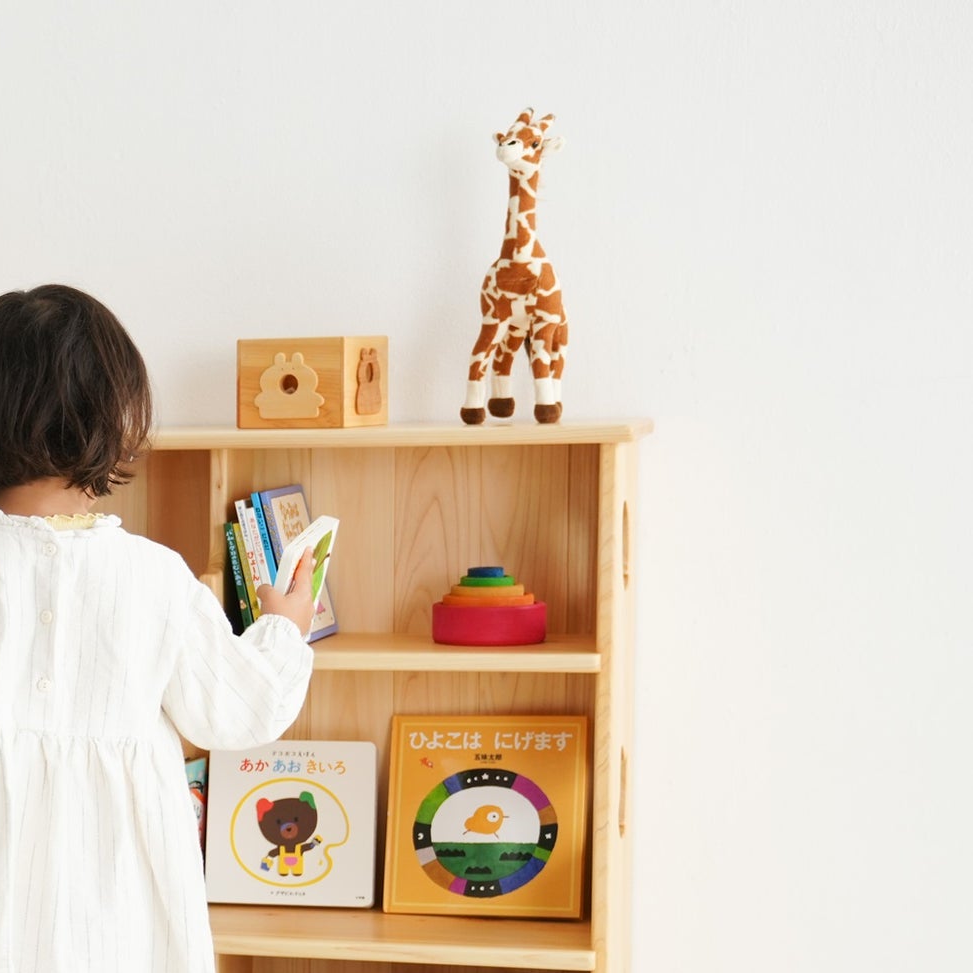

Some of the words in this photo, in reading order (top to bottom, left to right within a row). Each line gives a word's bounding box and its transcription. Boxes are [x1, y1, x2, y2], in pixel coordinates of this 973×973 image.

[409, 731, 482, 750] ひよこは
[494, 731, 573, 751] にげます
[239, 758, 269, 772] あか
[272, 759, 301, 773] あお
[306, 759, 346, 775] きいろ
